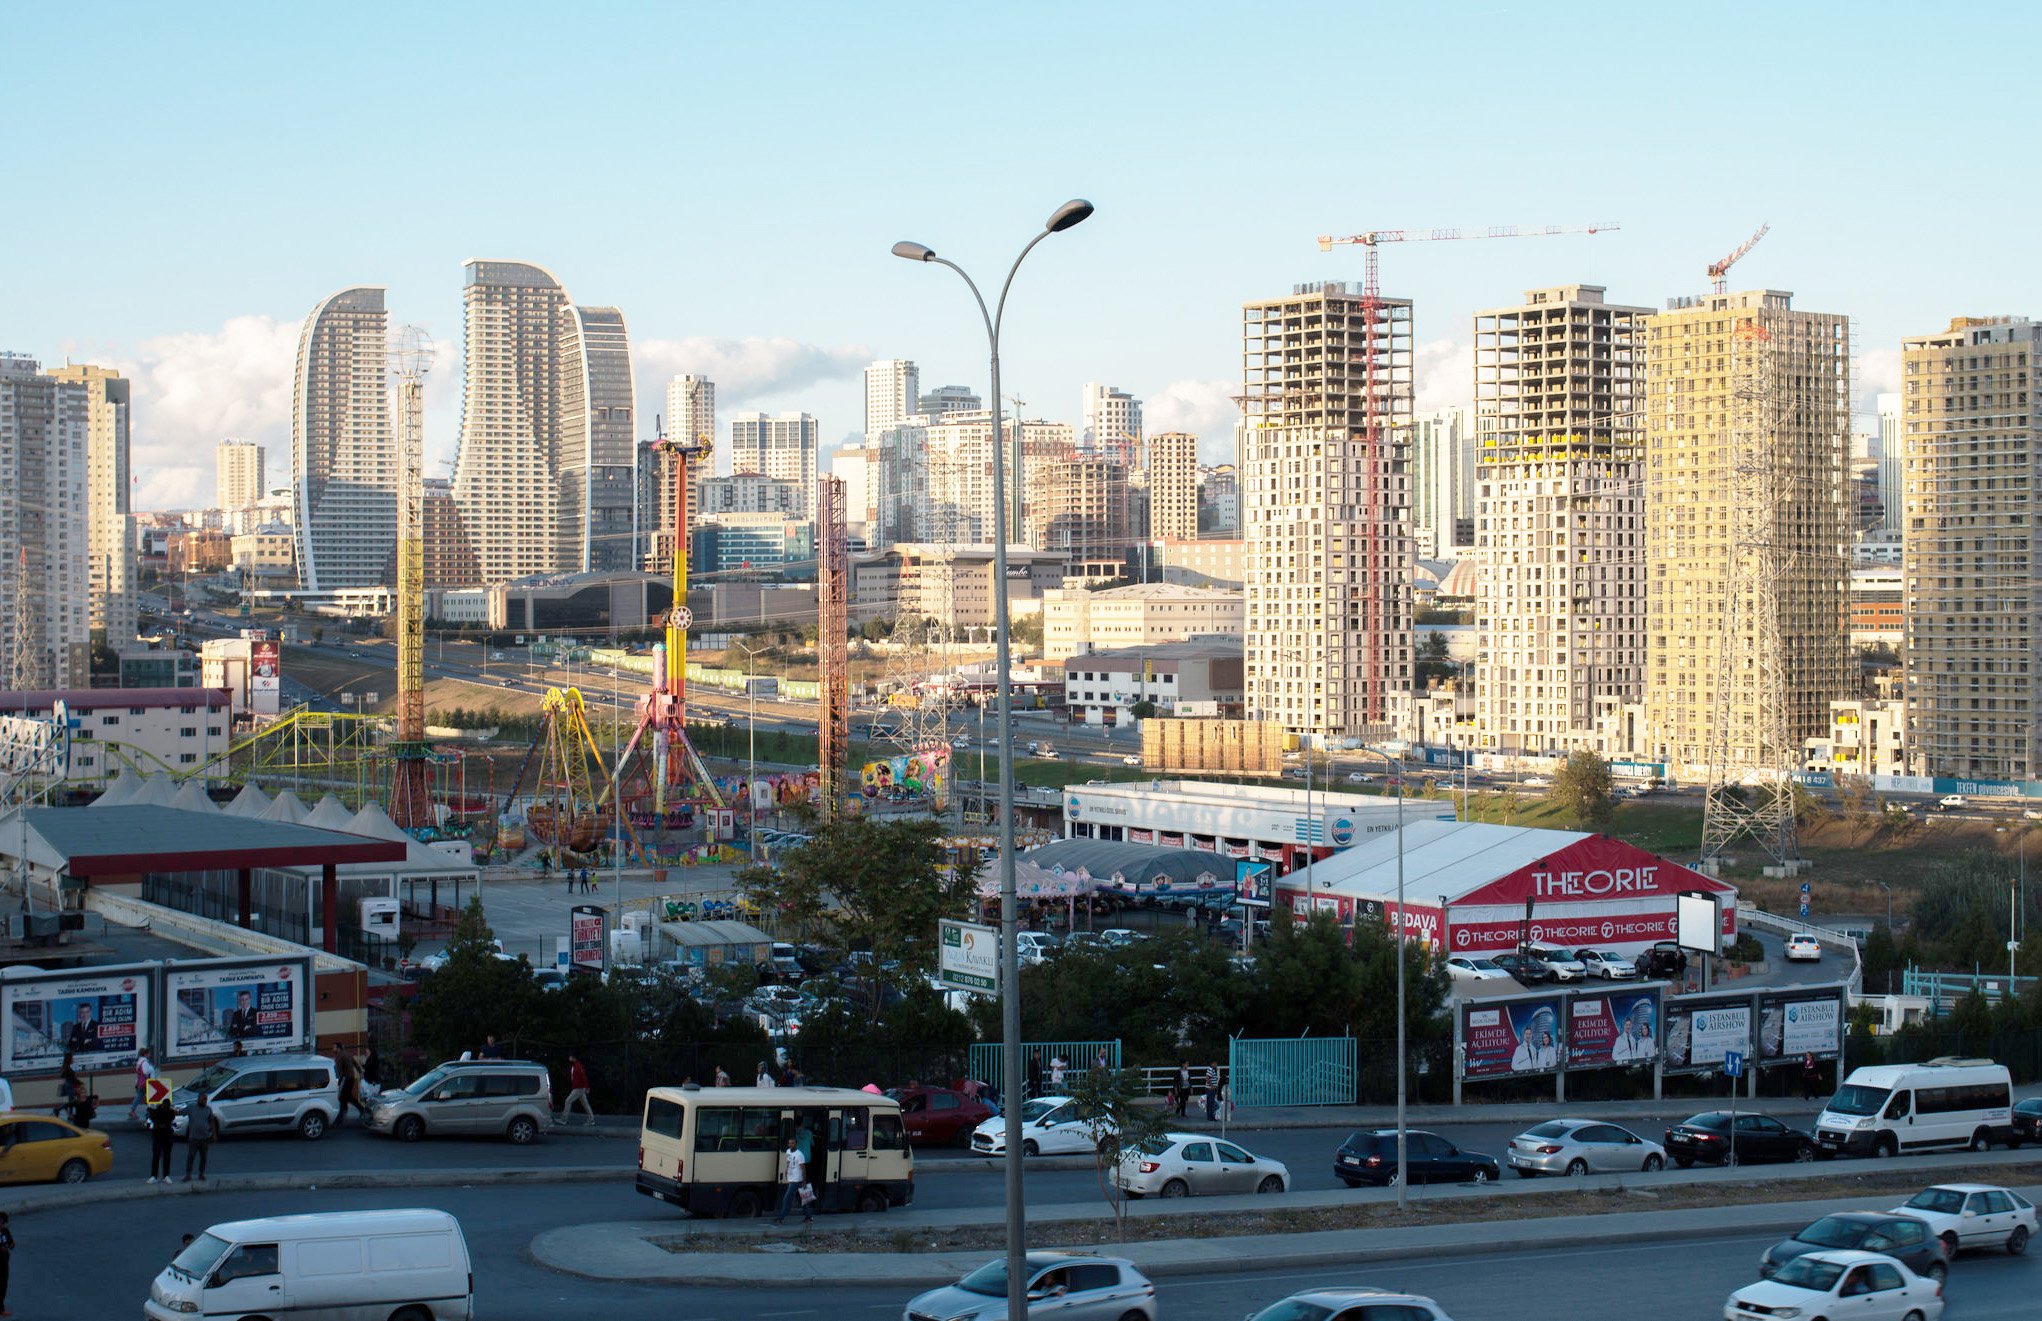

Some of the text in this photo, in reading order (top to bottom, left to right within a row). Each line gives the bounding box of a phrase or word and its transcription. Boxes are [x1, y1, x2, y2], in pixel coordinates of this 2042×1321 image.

[530, 579, 574, 587] SUNNY
[1956, 781, 1978, 794] TEKFEN
[1531, 866, 1658, 896] THEORIE
[1391, 911, 1437, 930] BDAVA
[1545, 925, 1598, 938] THEORIE
[1615, 921, 1665, 934] THEORIE
[1801, 1012, 1834, 1022] AIRSHOW
[1578, 1018, 1607, 1029] EKİM'DE
[1709, 1020, 1745, 1031] AIRSHOW
[1475, 1028, 1507, 1039] EKİM'DE
[1574, 1028, 1611, 1039] AÇILIYOR!
[1471, 1038, 1510, 1050] AÇILIYOR!
